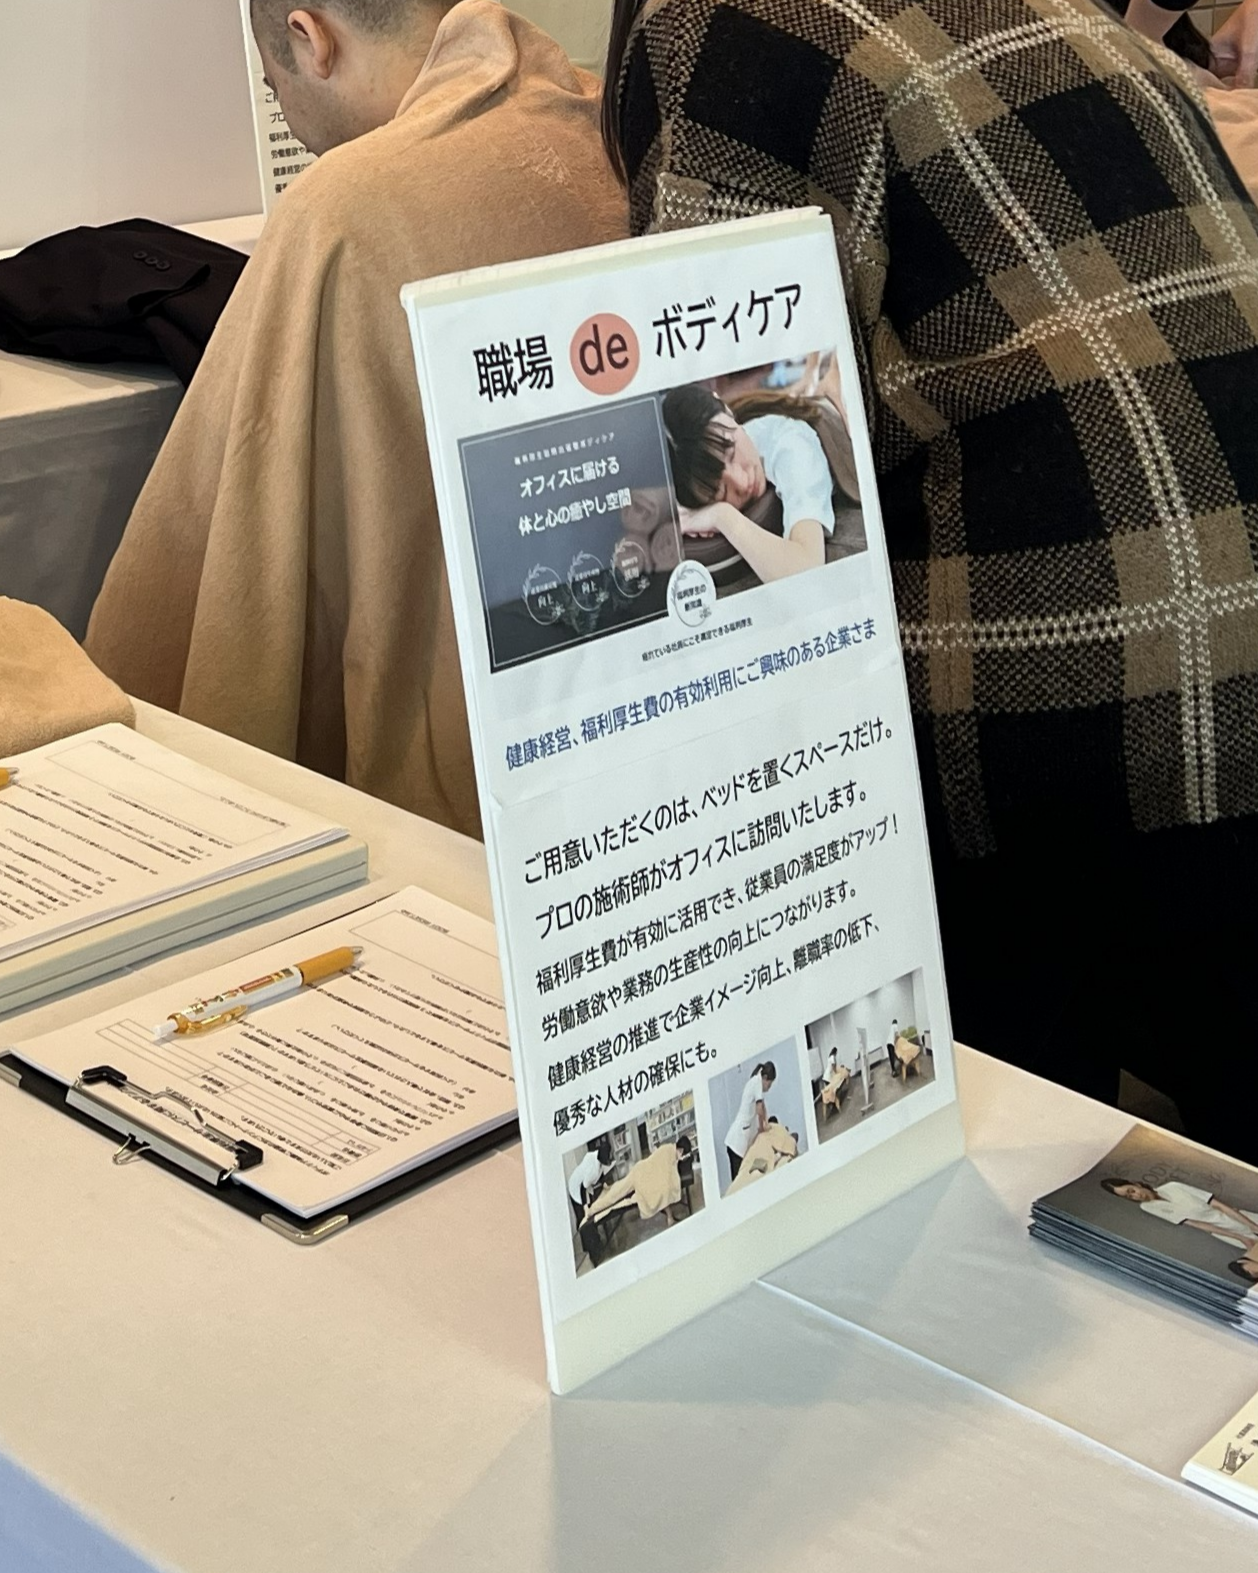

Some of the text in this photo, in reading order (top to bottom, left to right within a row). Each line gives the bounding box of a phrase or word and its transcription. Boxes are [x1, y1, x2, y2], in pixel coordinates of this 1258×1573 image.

[473, 283, 801, 402] 職場 de ボディケア
[518, 488, 632, 536] 体と心の癒やし空間
[520, 456, 620, 498] オフィスに届ける
[505, 617, 878, 771] 健康経営、福利厚生費の有効利用にご興味のある企業さま
[523, 721, 893, 886] ご用意いただくのは、ベッドを置くスペースだけ。
[535, 779, 867, 939] プロの施術師がオフィスに訪問いたします。
[542, 880, 857, 1042] 労働意欲や業務の生産性の向上につながります。
[547, 913, 881, 1091] 健康経営の推進で企業イメージ向上、離職率の低下、
[553, 1043, 719, 1137] 優秀な人材の確保にも。
